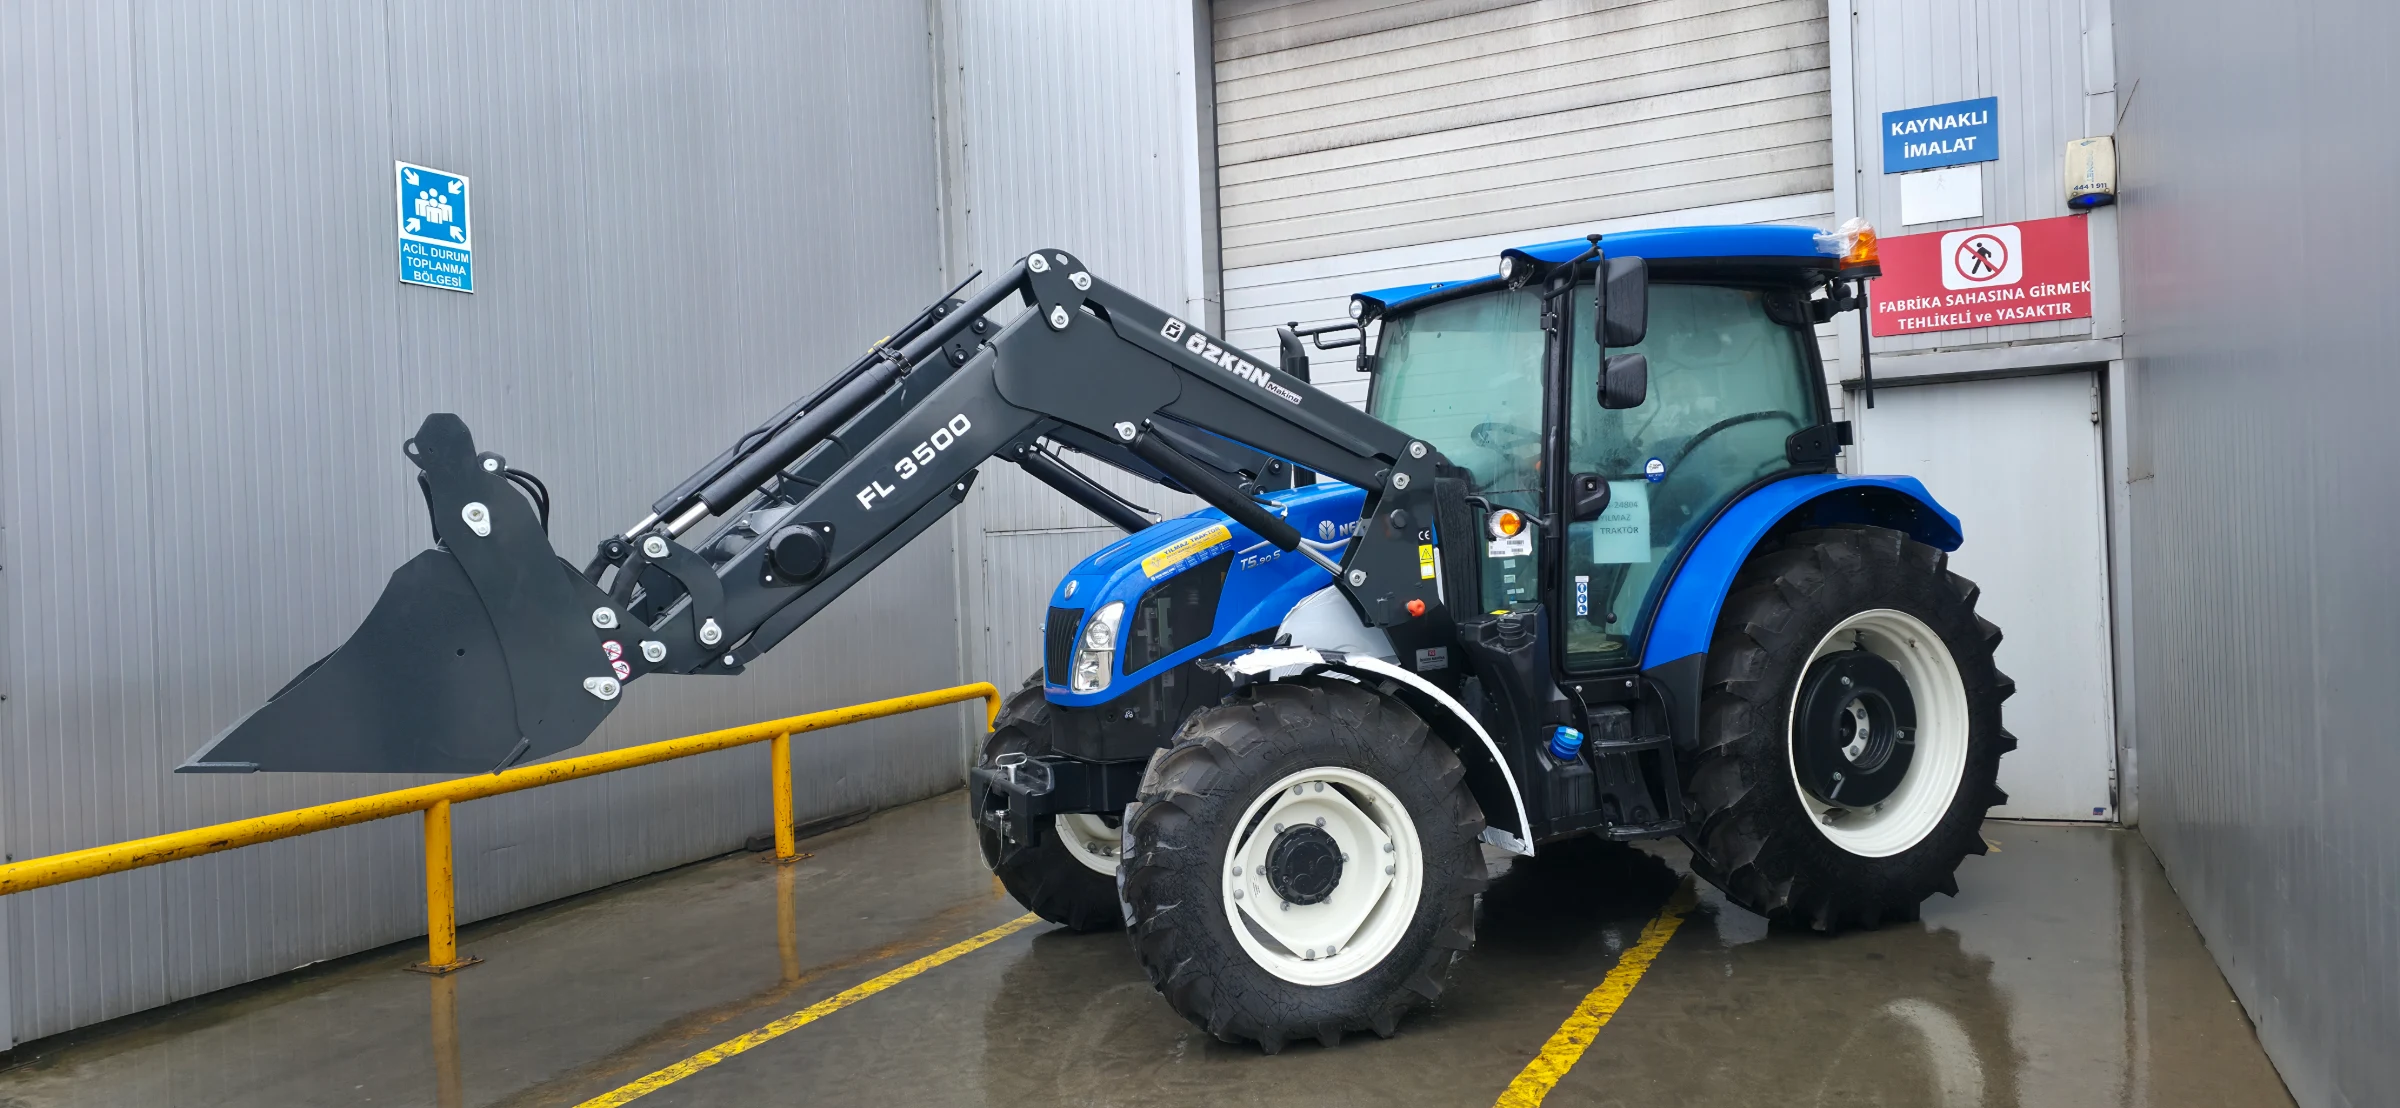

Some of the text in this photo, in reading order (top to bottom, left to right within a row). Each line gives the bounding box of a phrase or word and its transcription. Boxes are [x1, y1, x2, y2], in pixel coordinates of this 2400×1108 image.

[1891, 110, 1988, 136] KAYNAKLI
[1903, 136, 1977, 159] İMALAT
[403, 243, 469, 263] ACİL DURUM
[407, 256, 466, 276] TOPLANMA
[413, 271, 462, 287] BÖLGESİ
[1879, 280, 2091, 314] FABRİKA SAHASINA GİRMEK
[1897, 302, 2072, 330] TEHLİKELİ ve YASAKTIR
[1185, 332, 1300, 403] ÖZKAN Makina
[856, 413, 971, 510] FL 3500
[1600, 514, 1631, 522] YILMAZ
[1164, 541, 1189, 555] YILMAZ
[1240, 554, 1272, 571] T5.90
